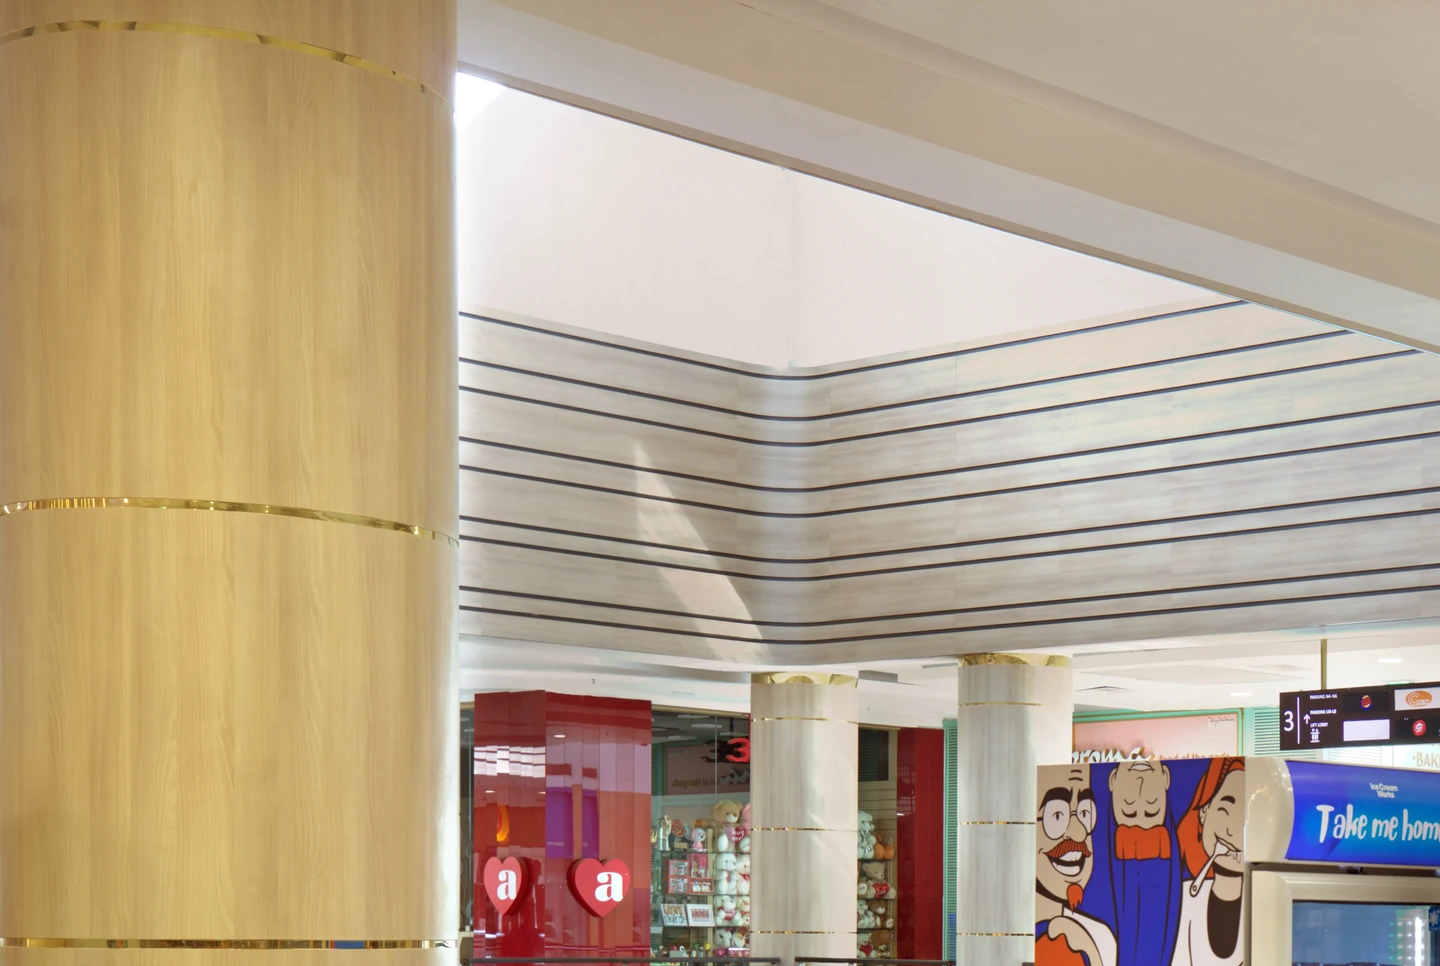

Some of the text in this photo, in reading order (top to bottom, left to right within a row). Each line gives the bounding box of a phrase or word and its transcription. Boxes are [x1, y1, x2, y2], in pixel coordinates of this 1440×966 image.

[1283, 710, 1295, 732] 3
[1316, 804, 1368, 844] Take
[1371, 816, 1399, 842] me
[497, 869, 517, 901] a
[594, 871, 624, 902] a
